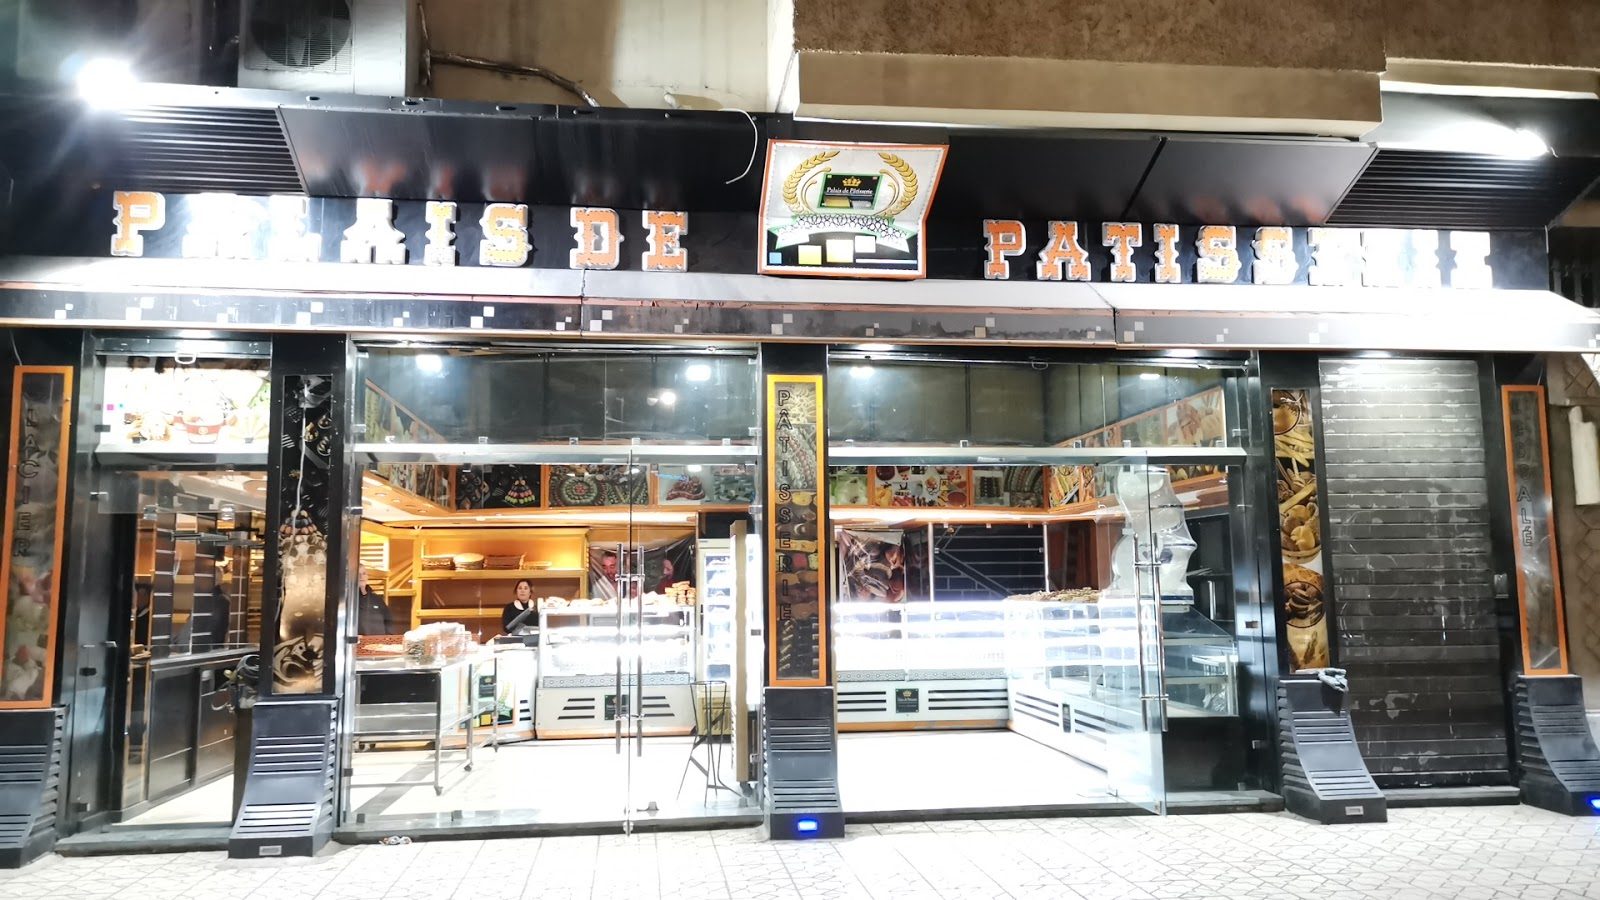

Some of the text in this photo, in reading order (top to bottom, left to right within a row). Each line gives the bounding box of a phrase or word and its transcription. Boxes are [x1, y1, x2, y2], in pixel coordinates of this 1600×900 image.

[111, 191, 688, 272] PLAIS DE
[984, 219, 1493, 289] PATISSIE
[13, 381, 39, 557] LACIER
[777, 389, 793, 621] PÂTISSERIE
